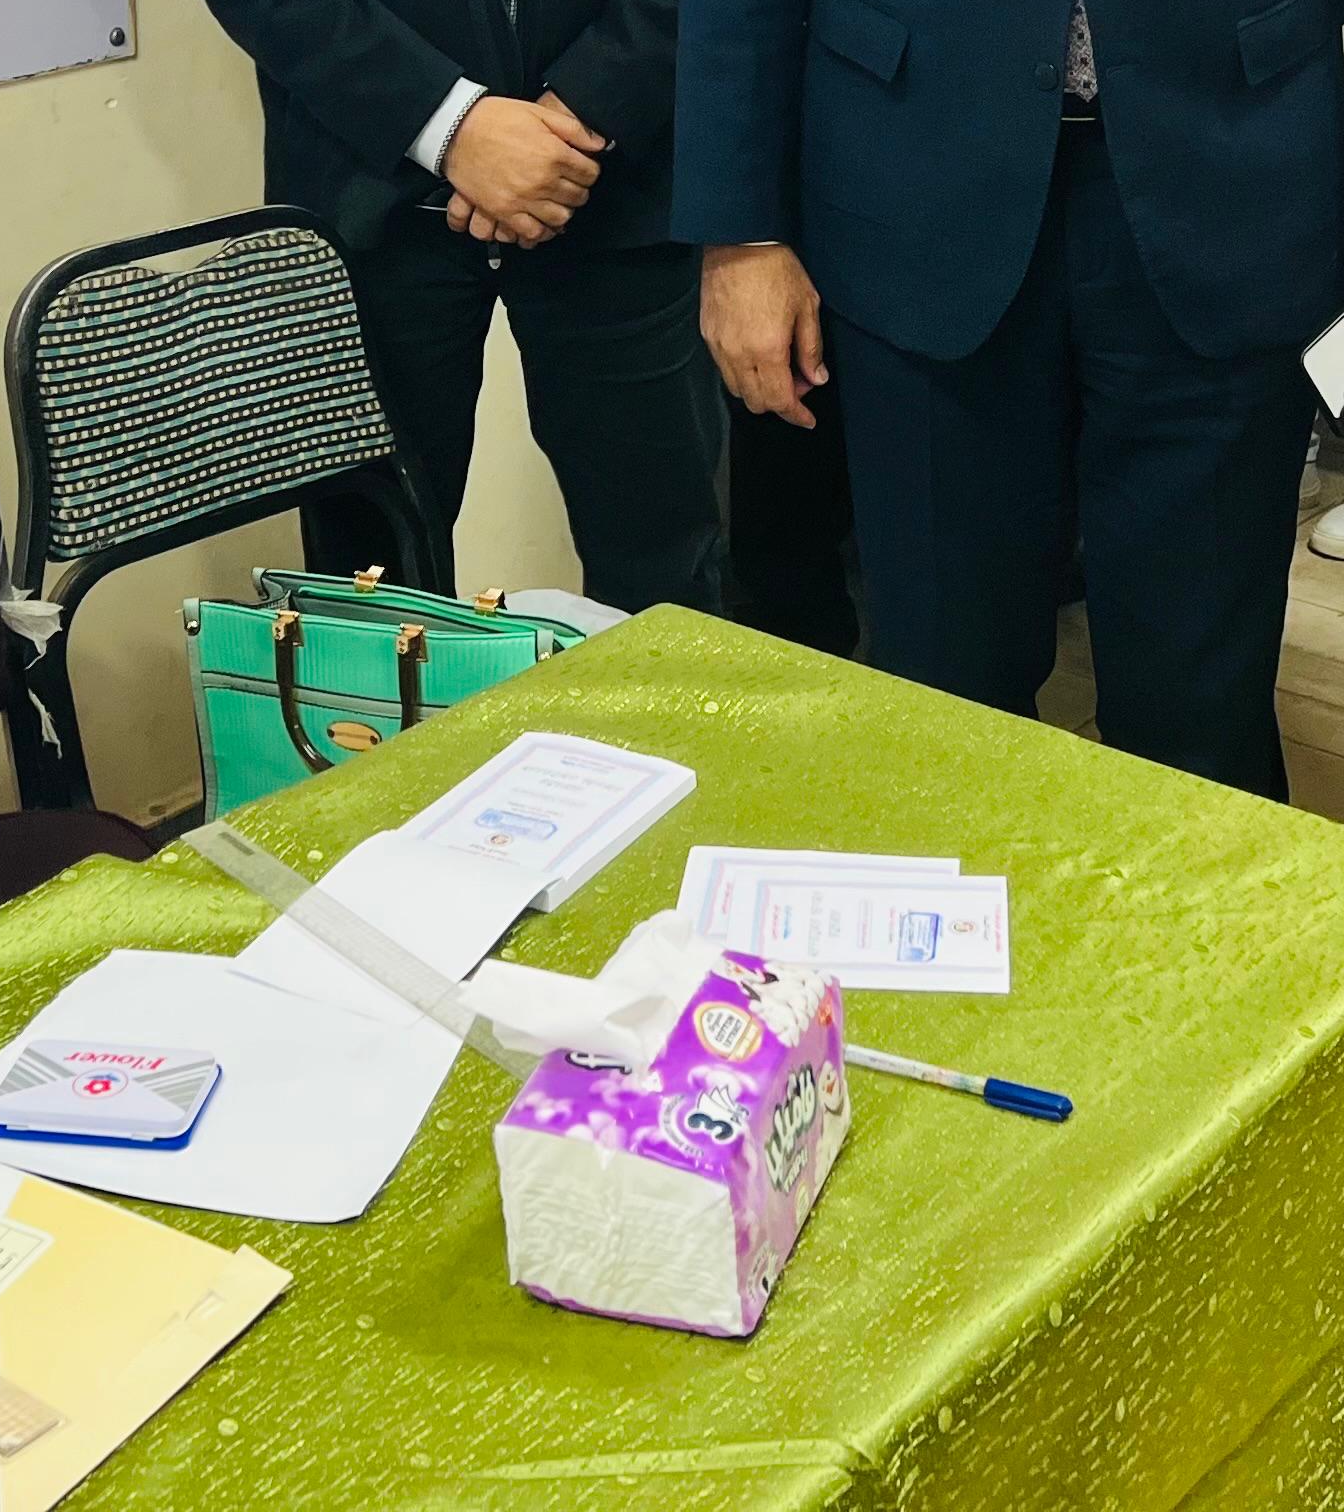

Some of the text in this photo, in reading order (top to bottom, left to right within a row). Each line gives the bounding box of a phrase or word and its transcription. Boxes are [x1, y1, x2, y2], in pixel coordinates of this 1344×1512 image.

[714, 1015, 736, 1044] COTTON
[63, 1050, 168, 1073] Flower
[686, 1112, 735, 1141] 3
